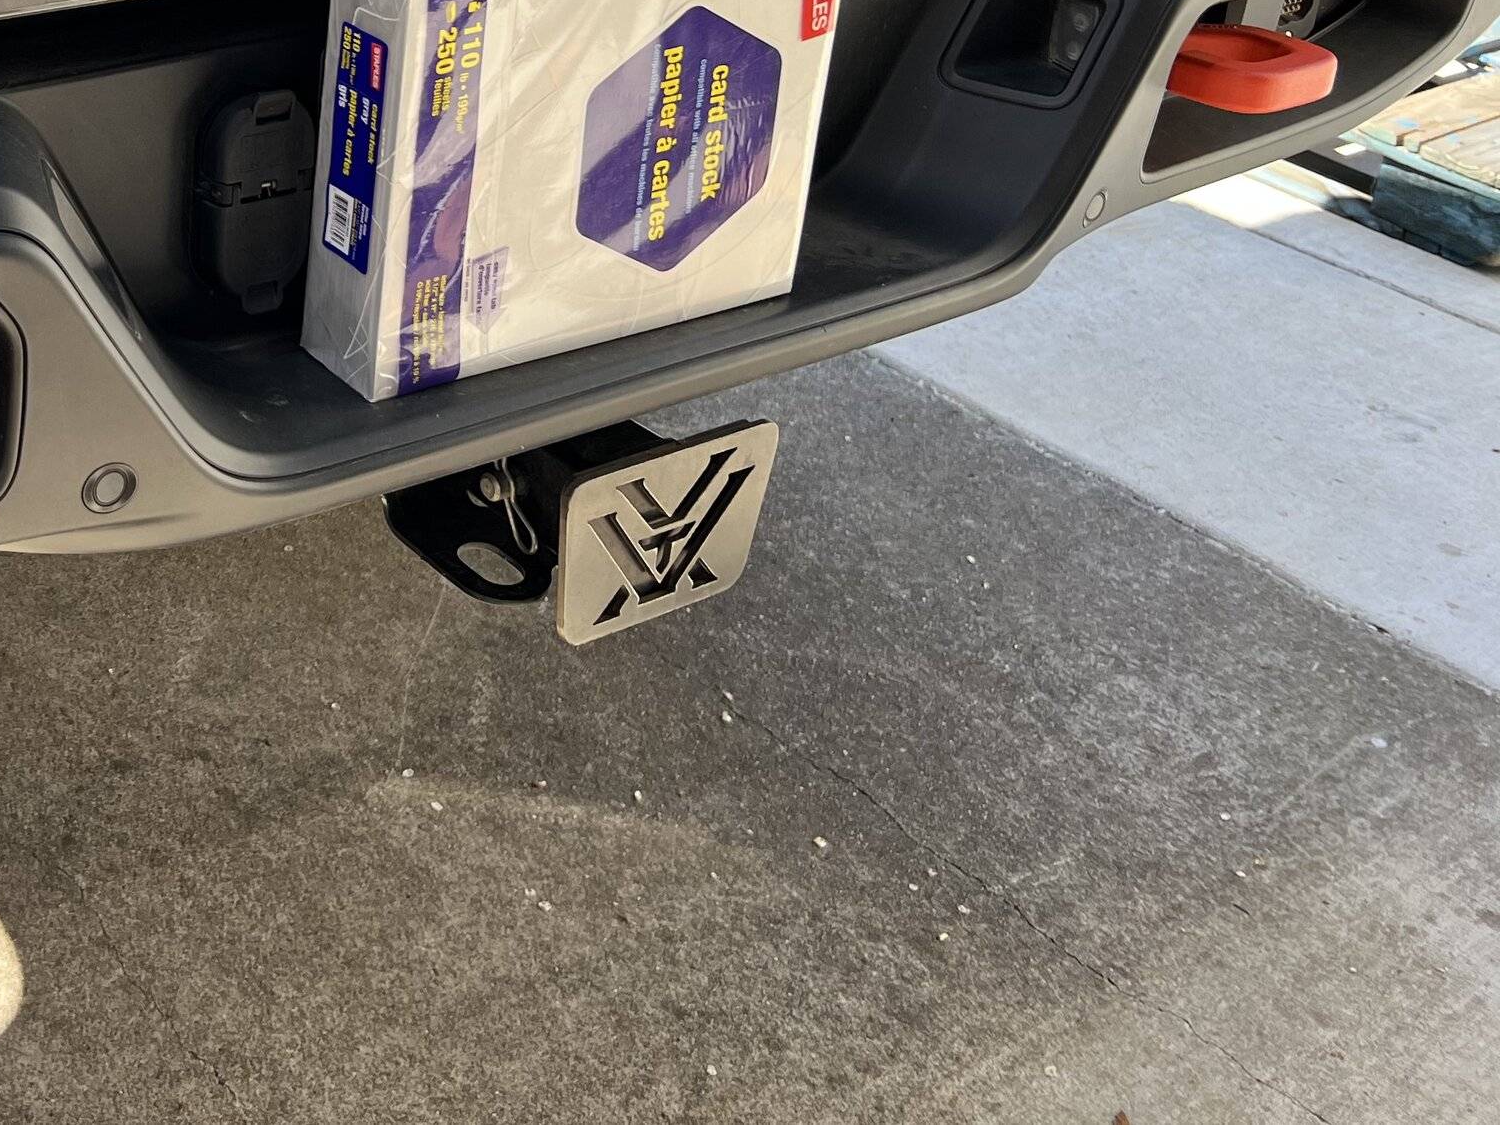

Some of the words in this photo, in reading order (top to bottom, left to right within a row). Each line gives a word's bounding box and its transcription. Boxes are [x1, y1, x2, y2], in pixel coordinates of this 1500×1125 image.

[342, 25, 353, 51] 250
[352, 32, 362, 53] 110
[435, 26, 458, 76] 250
[461, 21, 484, 69] 110
[338, 83, 348, 109] gris
[431, 78, 444, 117] feuilles
[441, 76, 453, 111] sheets
[659, 45, 685, 129] papier
[695, 58, 708, 108] compatible
[707, 64, 729, 124] card
[347, 89, 358, 129] papier
[360, 96, 370, 126] gray
[693, 109, 701, 130] with
[643, 118, 654, 147] toutes
[655, 136, 678, 154] à
[342, 138, 353, 177] cartes
[700, 129, 725, 203] stock
[636, 163, 647, 206] machines
[647, 159, 671, 242] cartes
